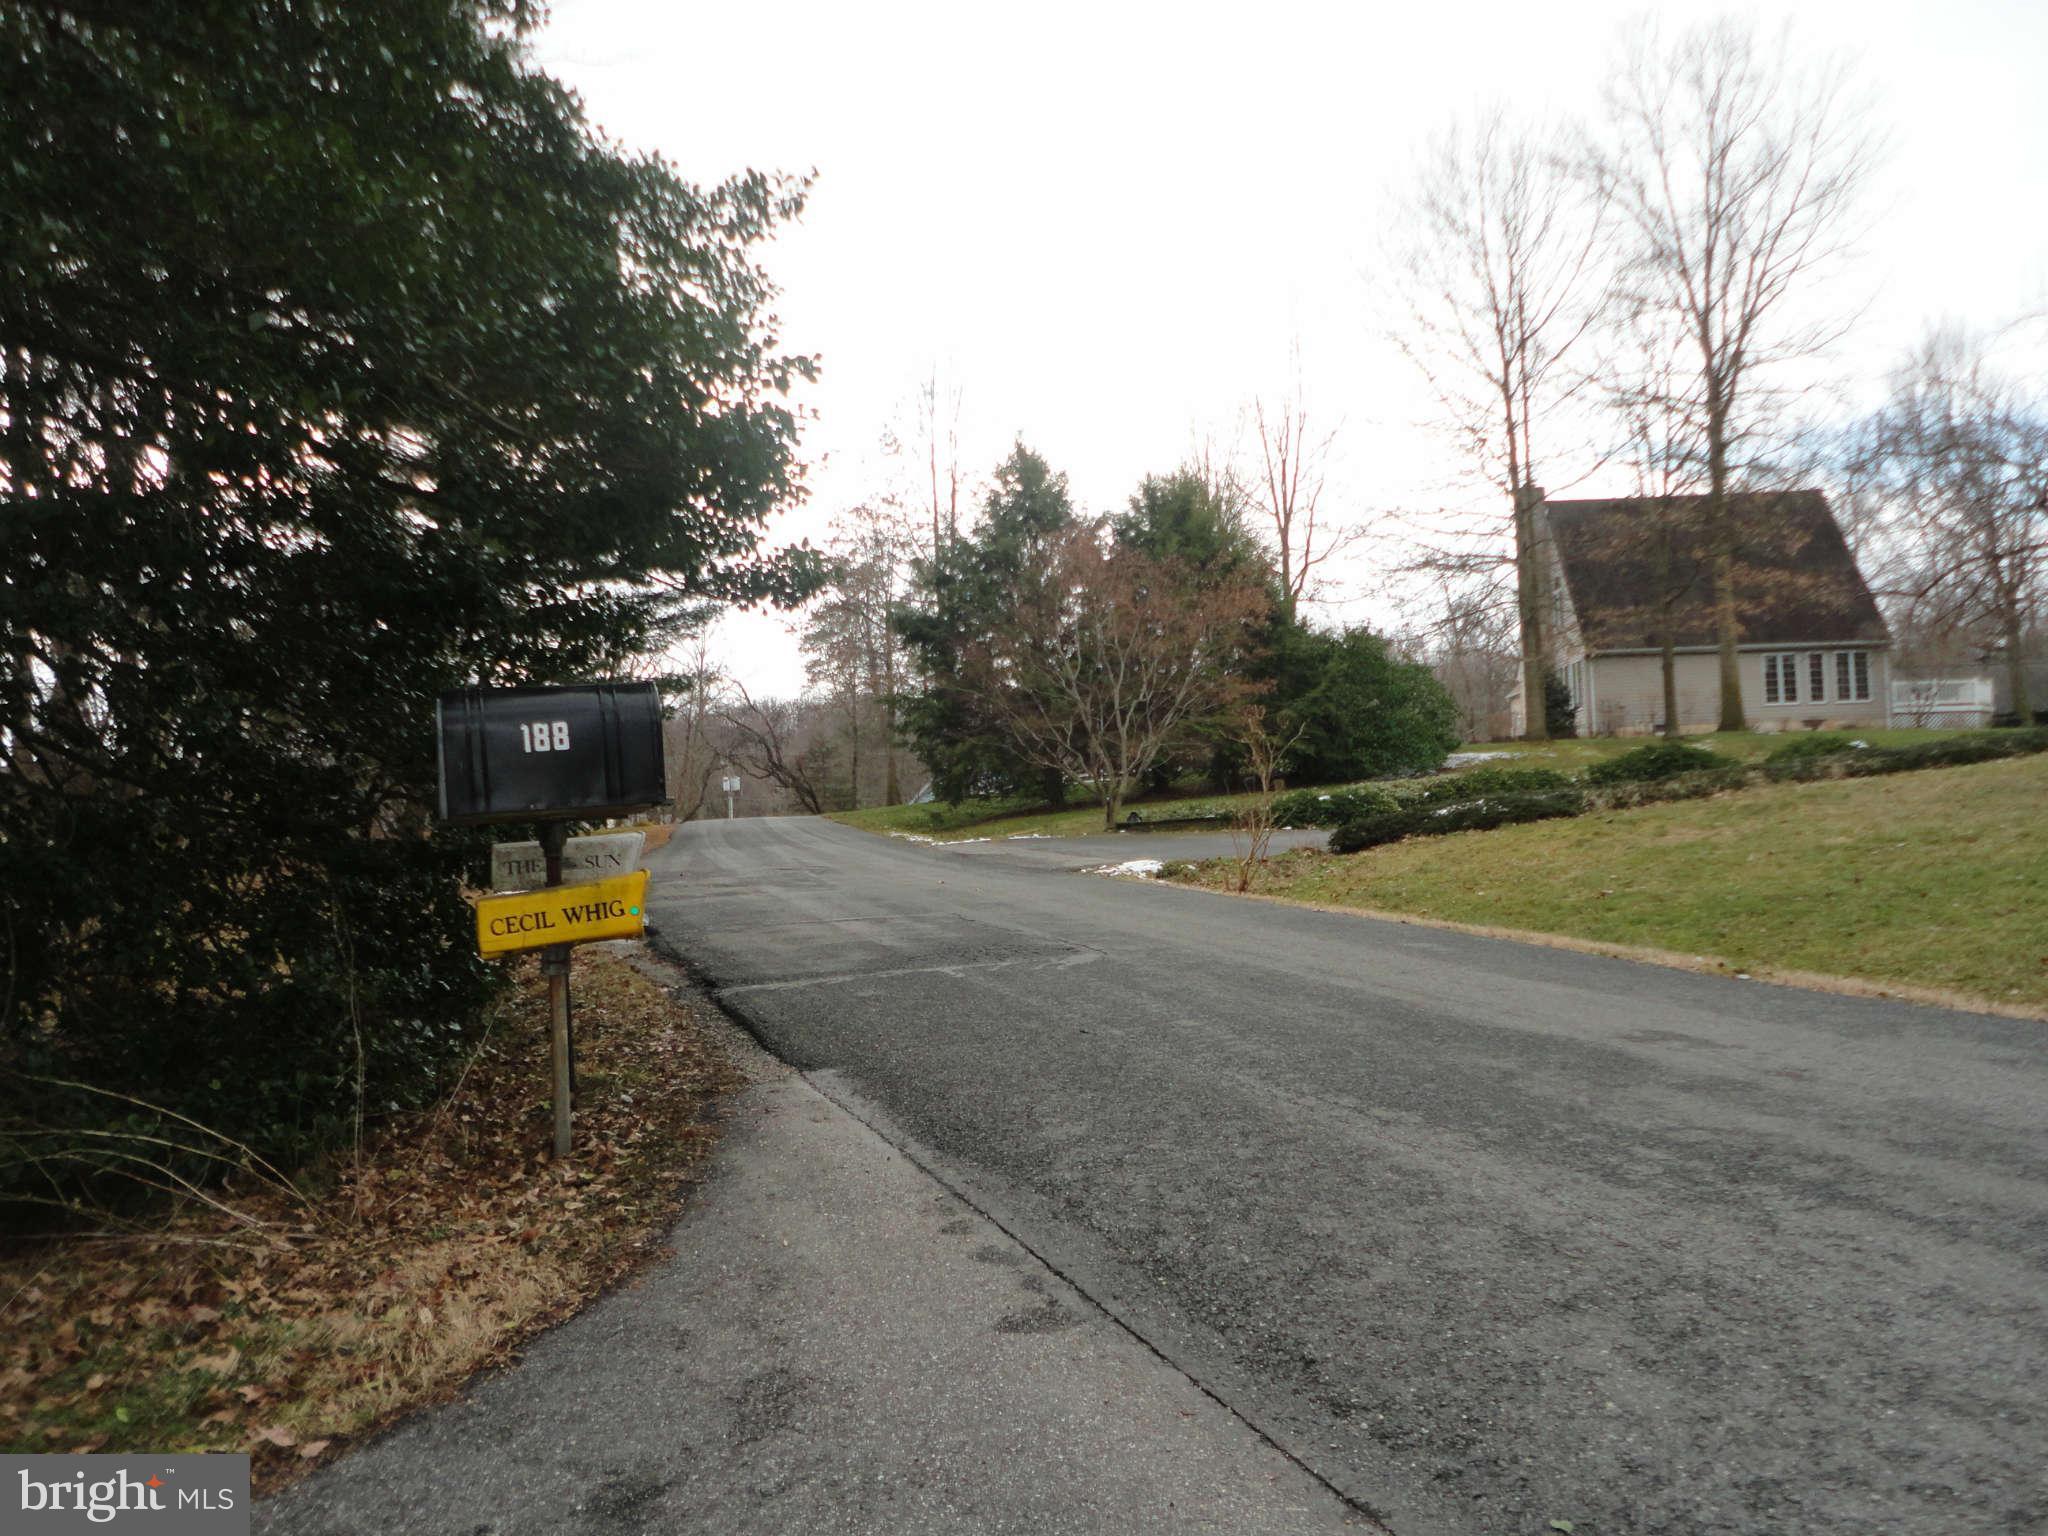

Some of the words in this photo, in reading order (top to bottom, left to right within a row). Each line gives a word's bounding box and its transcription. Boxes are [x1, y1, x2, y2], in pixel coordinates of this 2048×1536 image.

[520, 721, 570, 753] 188
[503, 861, 543, 876] THE
[584, 853, 623, 869] SUN
[490, 911, 556, 936] CECIL
[562, 900, 626, 925] WHIG
